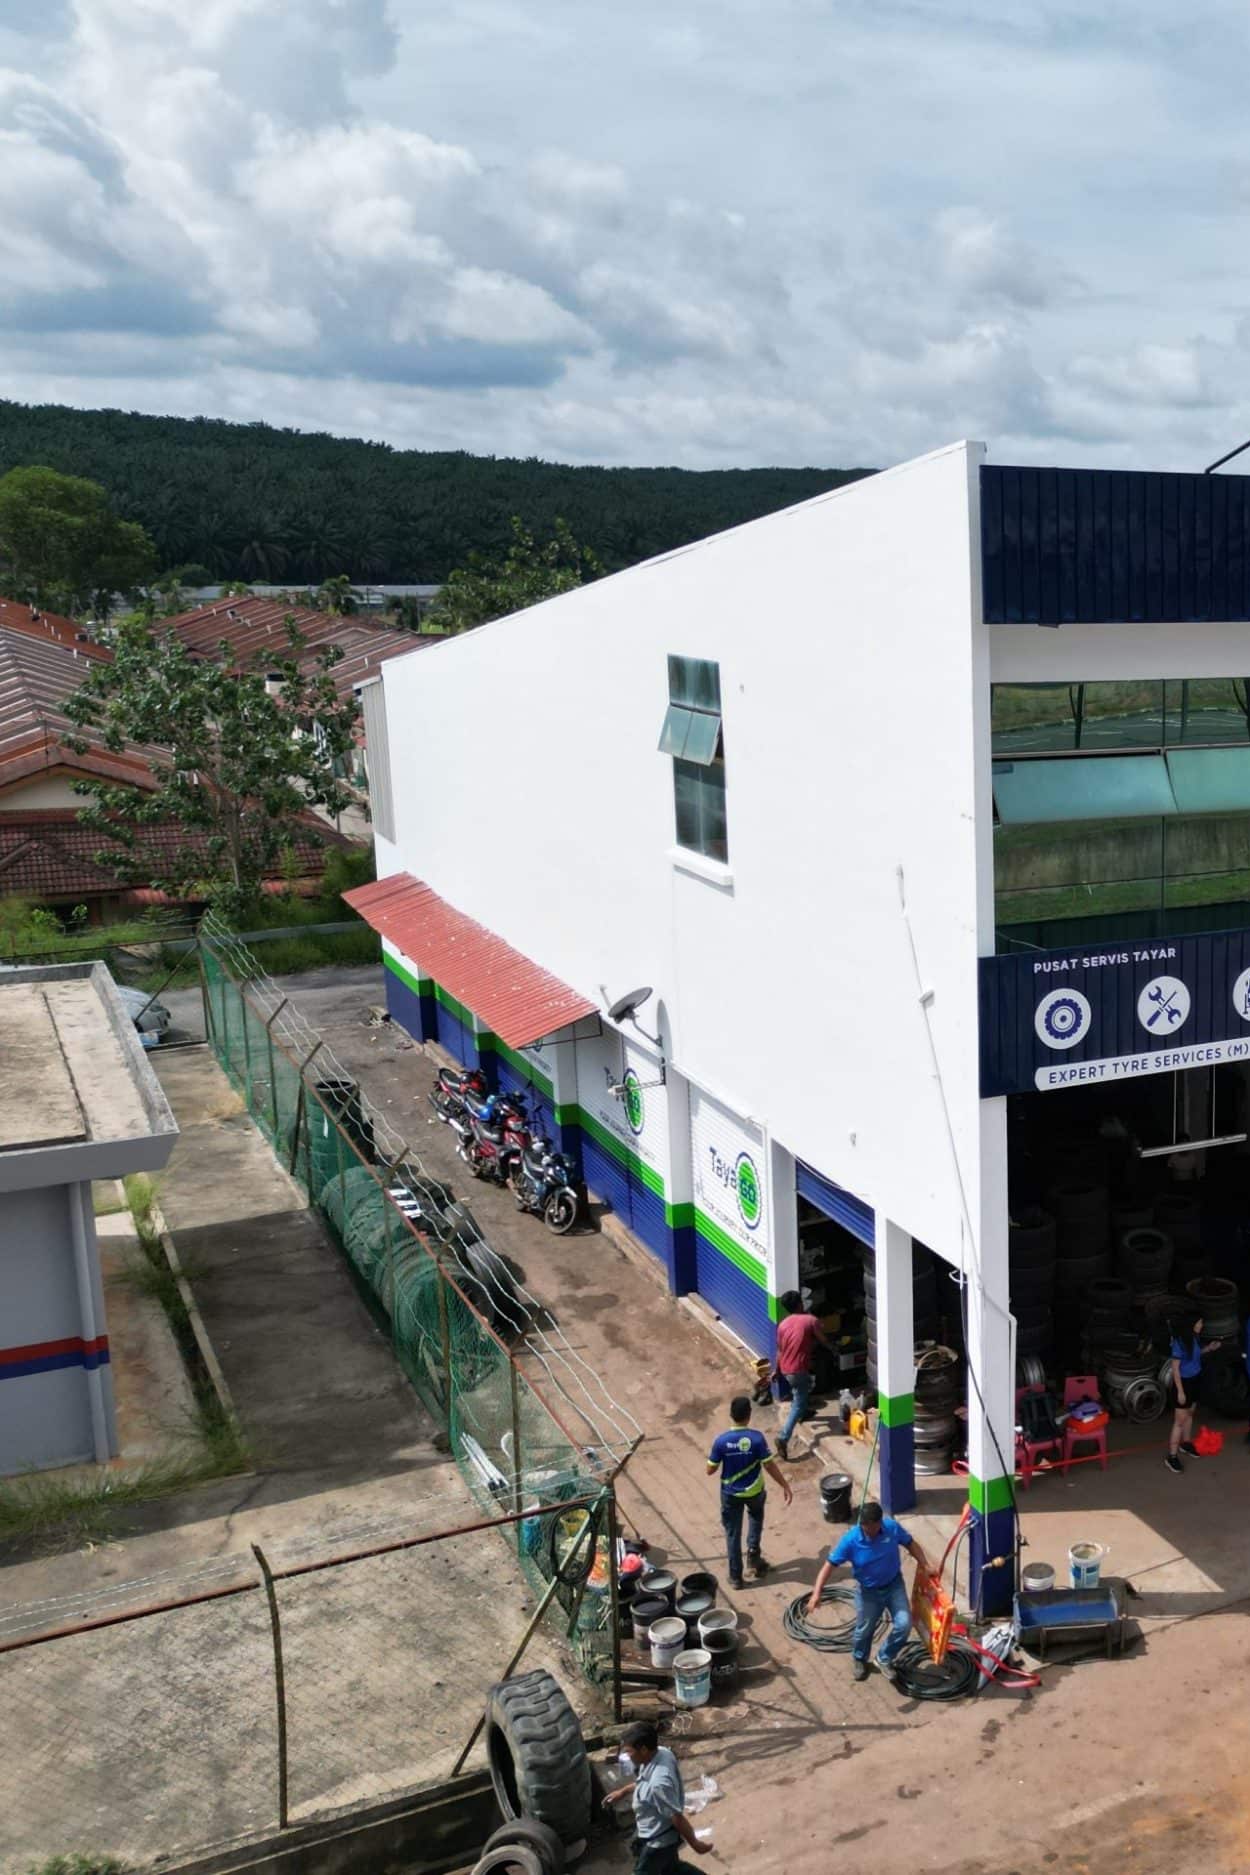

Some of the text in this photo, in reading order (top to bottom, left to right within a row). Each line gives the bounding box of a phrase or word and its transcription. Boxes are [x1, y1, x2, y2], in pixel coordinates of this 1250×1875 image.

[1034, 948, 1176, 974] PUSAT SERVIS TAYAR
[1048, 1064, 1107, 1084] EXPERT
[1112, 1058, 1149, 1074] TYRE
[1154, 1047, 1222, 1068] SERVICES
[1227, 1043, 1249, 1058] (M)
